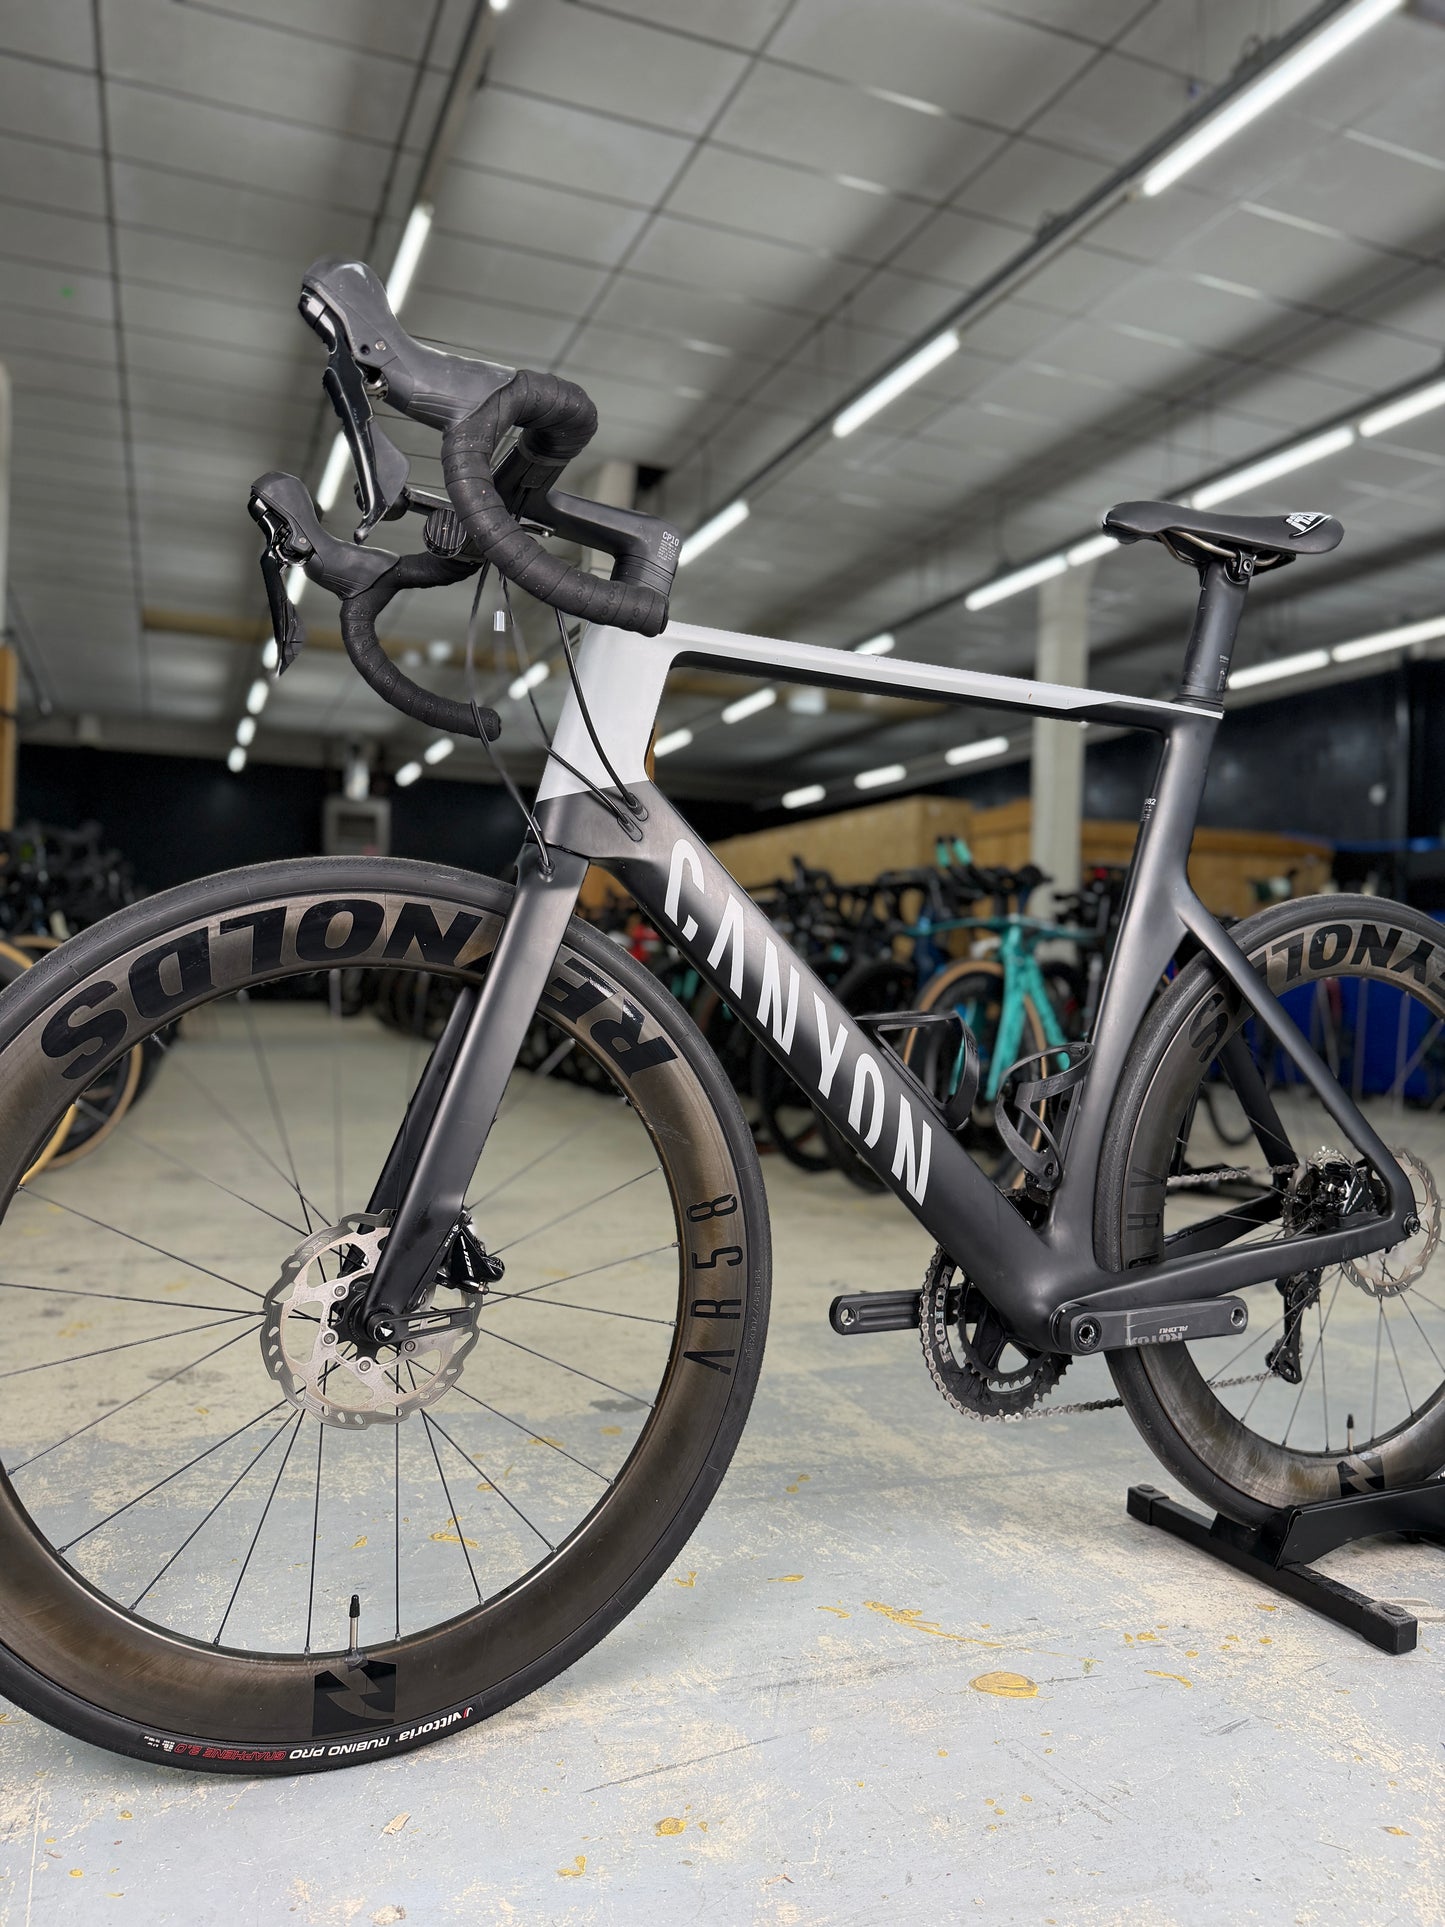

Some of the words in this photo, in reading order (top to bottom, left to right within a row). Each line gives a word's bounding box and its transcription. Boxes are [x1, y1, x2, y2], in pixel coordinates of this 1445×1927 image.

[662, 531, 680, 547] CP10
[41, 898, 679, 1082] RENOLDS
[664, 838, 932, 1207] CANYON
[684, 1193, 747, 1375] AR58
[205, 1747, 286, 1762] GRAPHENE
[289, 1746, 326, 1761] PRO
[328, 1735, 391, 1757] RUBINO
